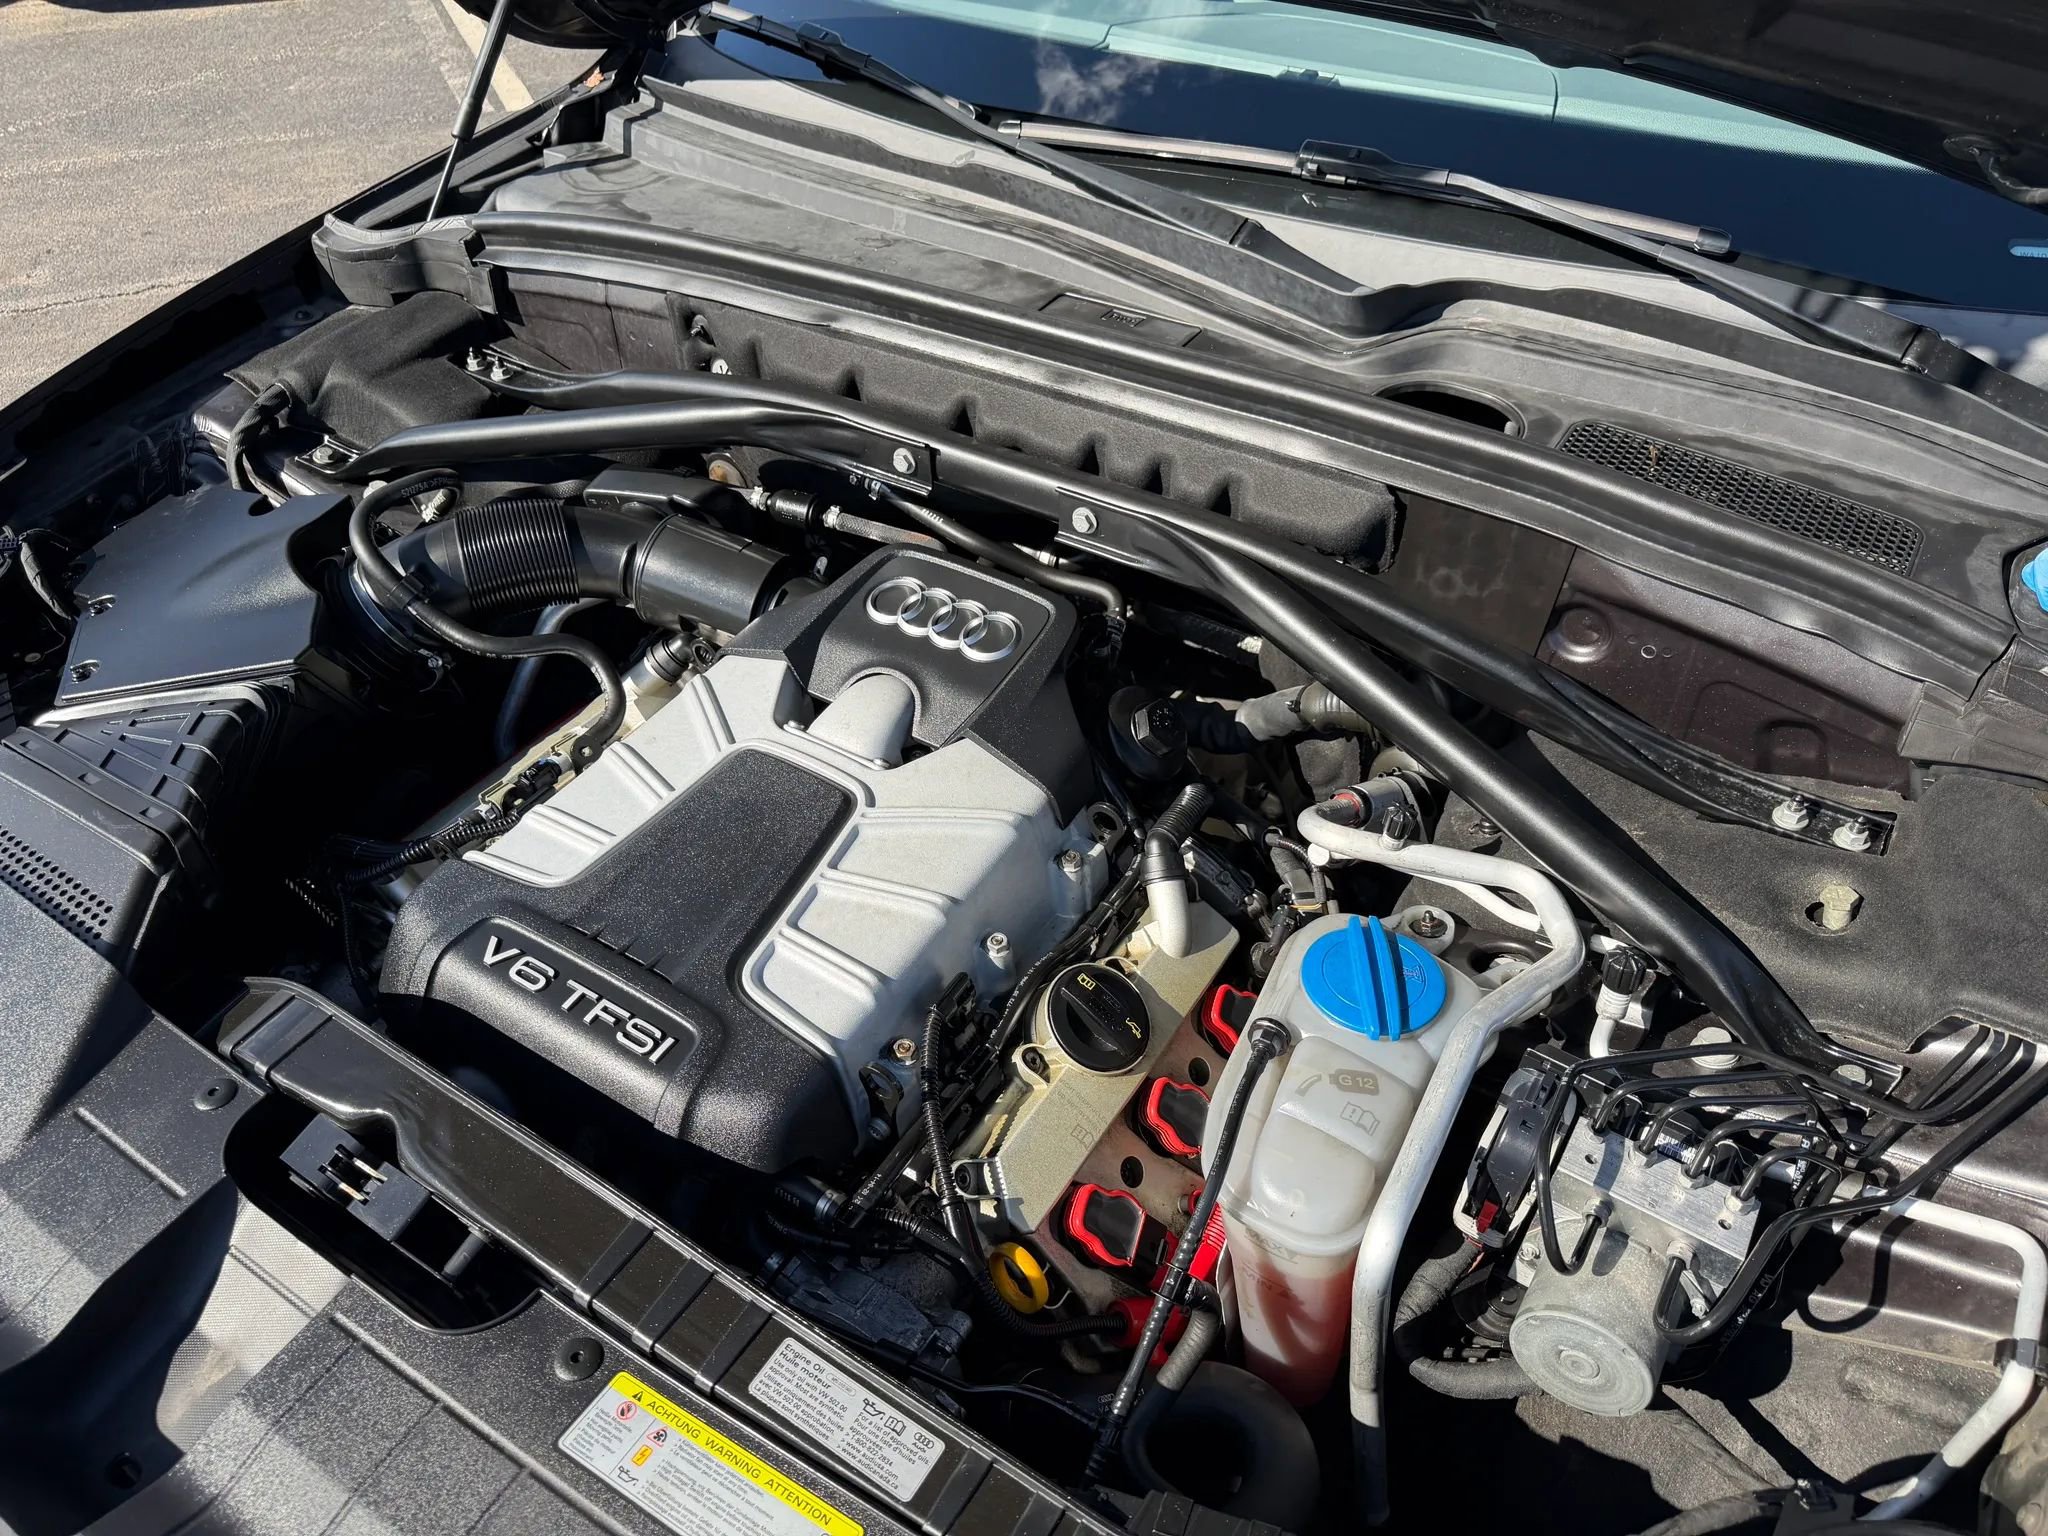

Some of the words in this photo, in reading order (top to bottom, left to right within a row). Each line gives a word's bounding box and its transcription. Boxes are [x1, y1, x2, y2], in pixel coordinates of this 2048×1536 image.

[483, 935, 556, 993] V6
[561, 979, 676, 1065] TFSI
[1338, 1074, 1353, 1086] G
[1355, 1077, 1376, 1089] 12
[777, 1349, 801, 1368] Huile
[799, 1364, 833, 1390] moteur
[782, 1342, 813, 1367] Engine
[811, 1361, 826, 1375] Oil
[757, 1377, 773, 1390] avec
[771, 1386, 783, 1398] VW
[781, 1394, 794, 1405] 502
[791, 1401, 802, 1410] 00
[762, 1370, 784, 1389] Utiliser
[781, 1384, 817, 1412] uniquement
[815, 1408, 828, 1420] des
[825, 1416, 845, 1432] huiles
[767, 1363, 795, 1385] approval.
[793, 1381, 810, 1396] Most
[808, 1392, 819, 1402] are
[817, 1398, 846, 1422] synthetic.
[772, 1357, 786, 1369] Use
[782, 1365, 798, 1379] only
[796, 1373, 806, 1384] oil
[804, 1380, 819, 1392] with
[816, 1388, 830, 1400] VW
[827, 1396, 840, 1407] 502
[837, 1403, 848, 1413] 00
[752, 1383, 762, 1392] La
[759, 1388, 782, 1407] plupart
[780, 1402, 795, 1415] sont
[792, 1411, 832, 1442] synthétiques.
[856, 1411, 869, 1423] For
[872, 1421, 884, 1433] list
[881, 1428, 891, 1438] of
[888, 1433, 919, 1457] approved
[645, 1398, 702, 1440] ACHTUNG
[702, 1436, 762, 1479] WARNING
[762, 1476, 833, 1526] ATTENTION
[844, 1439, 900, 1481] www.audiusa.com
[852, 1417, 869, 1431] Pour
[866, 1428, 880, 1440] une
[878, 1435, 894, 1449] liste
[891, 1444, 917, 1465] d'huiles
[910, 1440, 927, 1454] Audi
[839, 1445, 900, 1490] www.audicanada.ca
